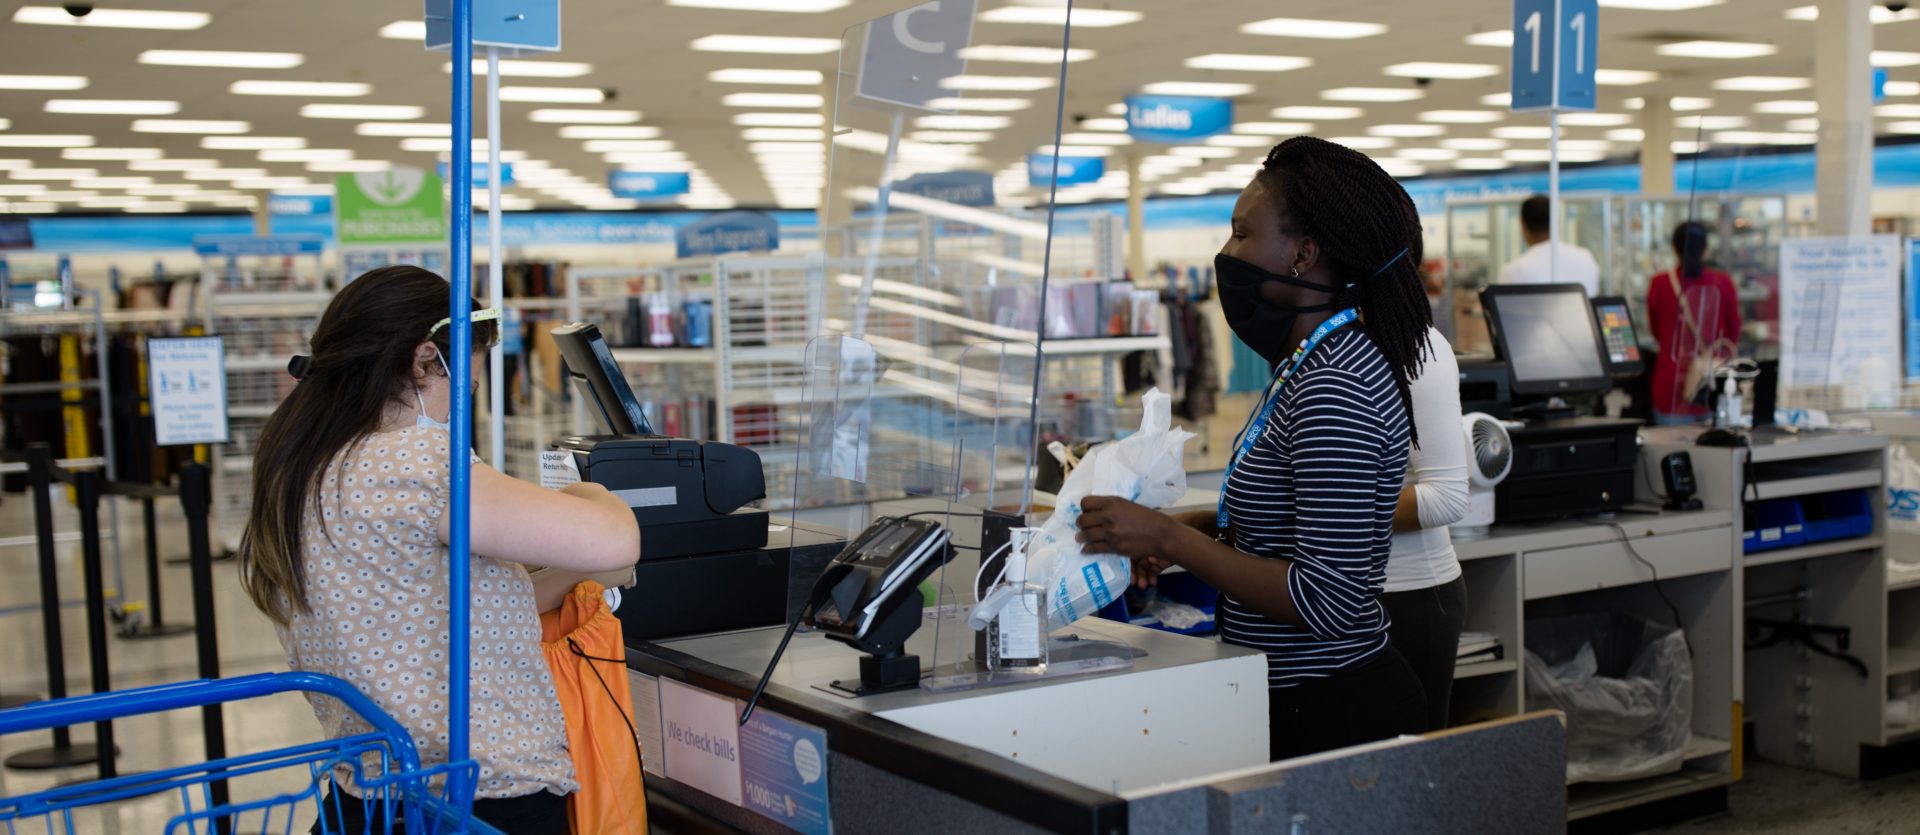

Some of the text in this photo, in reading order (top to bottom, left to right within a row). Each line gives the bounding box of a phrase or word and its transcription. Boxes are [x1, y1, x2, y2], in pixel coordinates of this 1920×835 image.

[1130, 104, 1191, 130] Ladies
[1246, 424, 1262, 444] ROSS
[667, 721, 682, 742] We
[684, 727, 712, 753] check
[714, 736, 736, 762] bills
